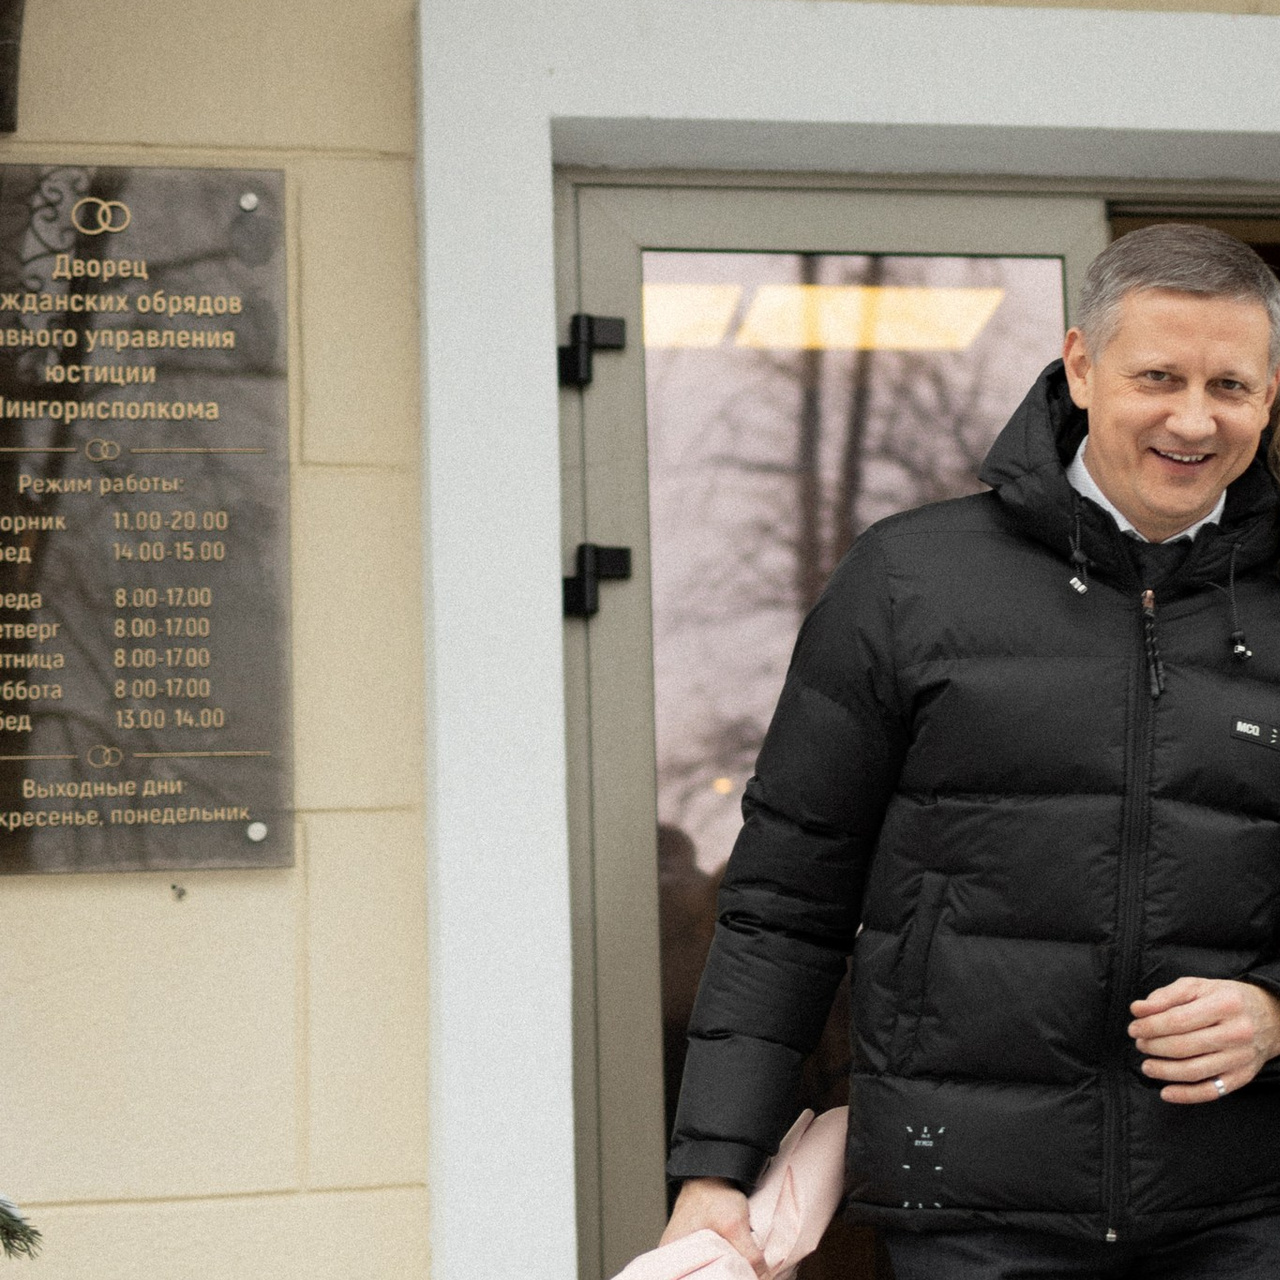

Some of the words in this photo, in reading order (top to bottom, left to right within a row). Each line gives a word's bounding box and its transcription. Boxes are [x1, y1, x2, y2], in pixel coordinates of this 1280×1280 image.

[52, 254, 149, 281] Дворец
[136, 289, 243, 317] обрядов
[85, 328, 236, 353] управления
[45, 364, 157, 388] юстиции
[0, 395, 220, 424] ингорисполкома
[18, 474, 93, 495] Режим
[99, 473, 186, 497] работы:
[113, 510, 230, 531] 11.00-20.00
[112, 540, 226, 562] 14.00-15.00
[114, 587, 213, 608] 8.00-17.00
[114, 617, 211, 638] 8.00-17.00
[114, 647, 211, 668] 8.00-17.00
[22, 778, 136, 800] Выходные
[111, 805, 252, 826] понедельник
